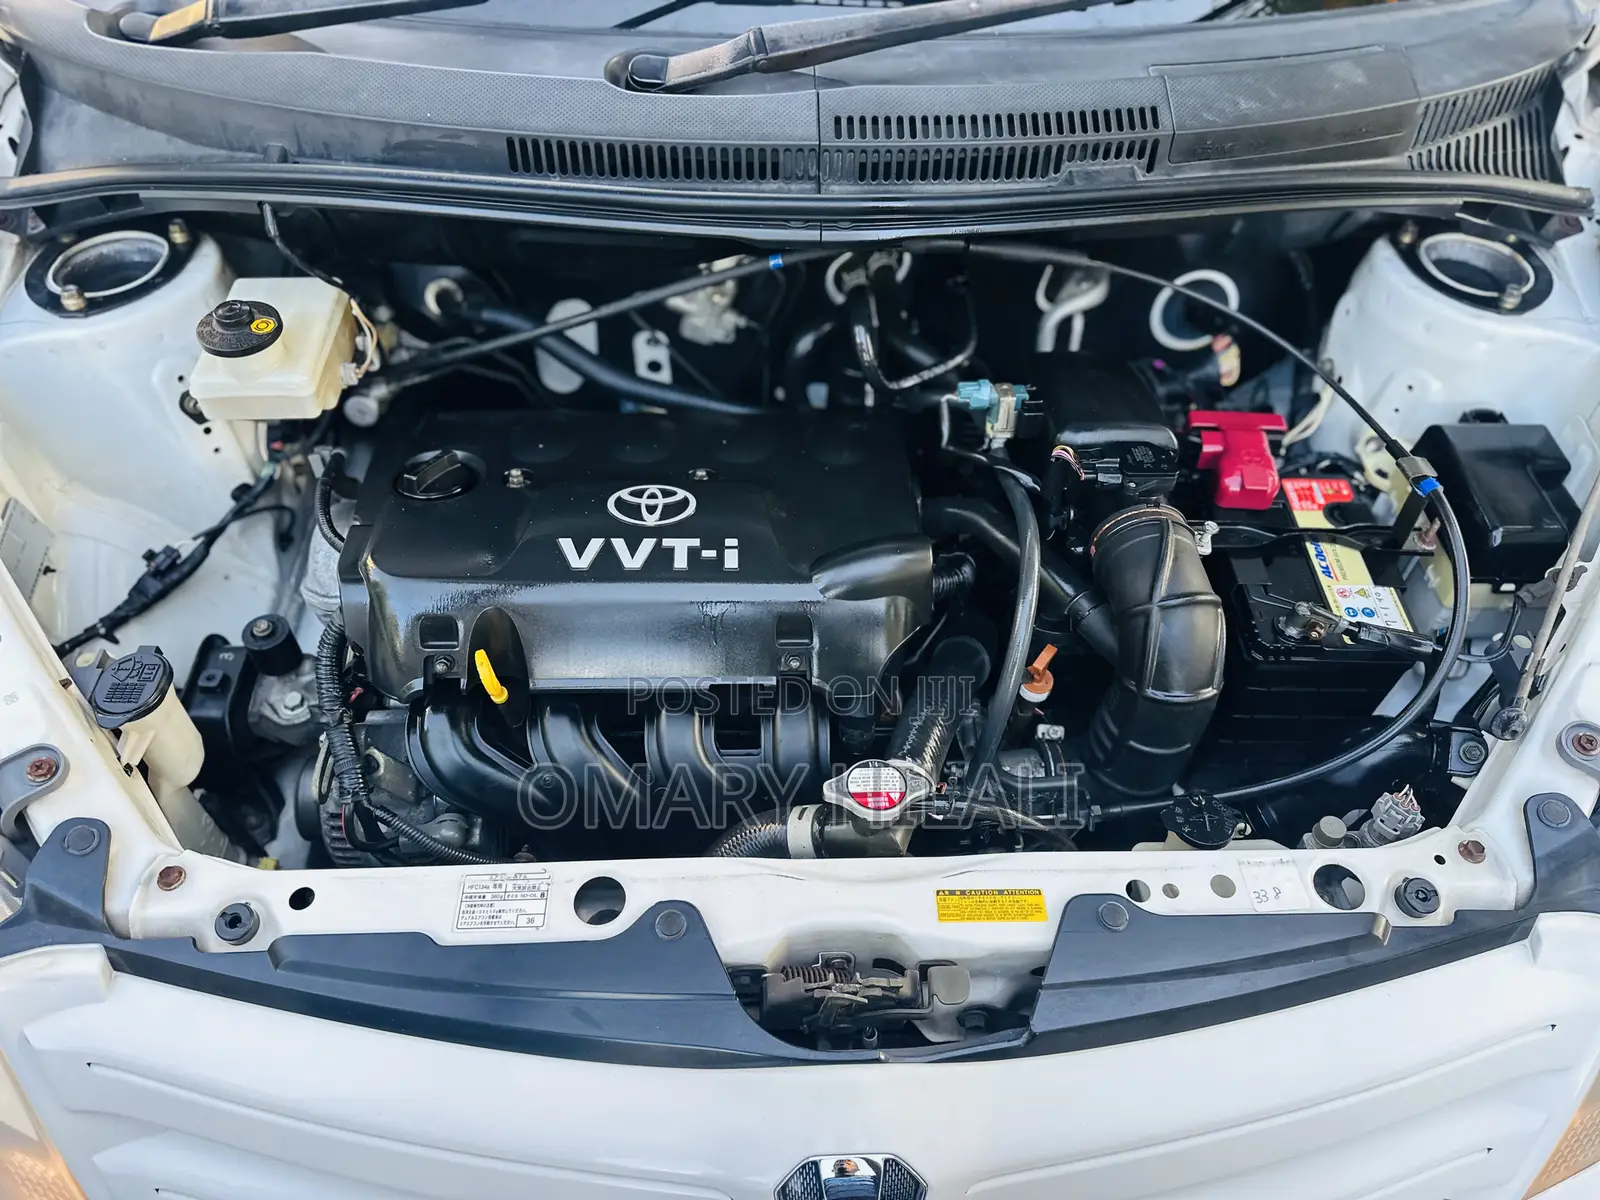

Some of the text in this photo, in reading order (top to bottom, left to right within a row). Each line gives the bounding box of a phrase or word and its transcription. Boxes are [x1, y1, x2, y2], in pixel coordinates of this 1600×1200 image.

[556, 537, 740, 570] VVT-i
[539, 891, 546, 899] 8
[1253, 889, 1270, 904] 33
[526, 916, 536, 925] 36
